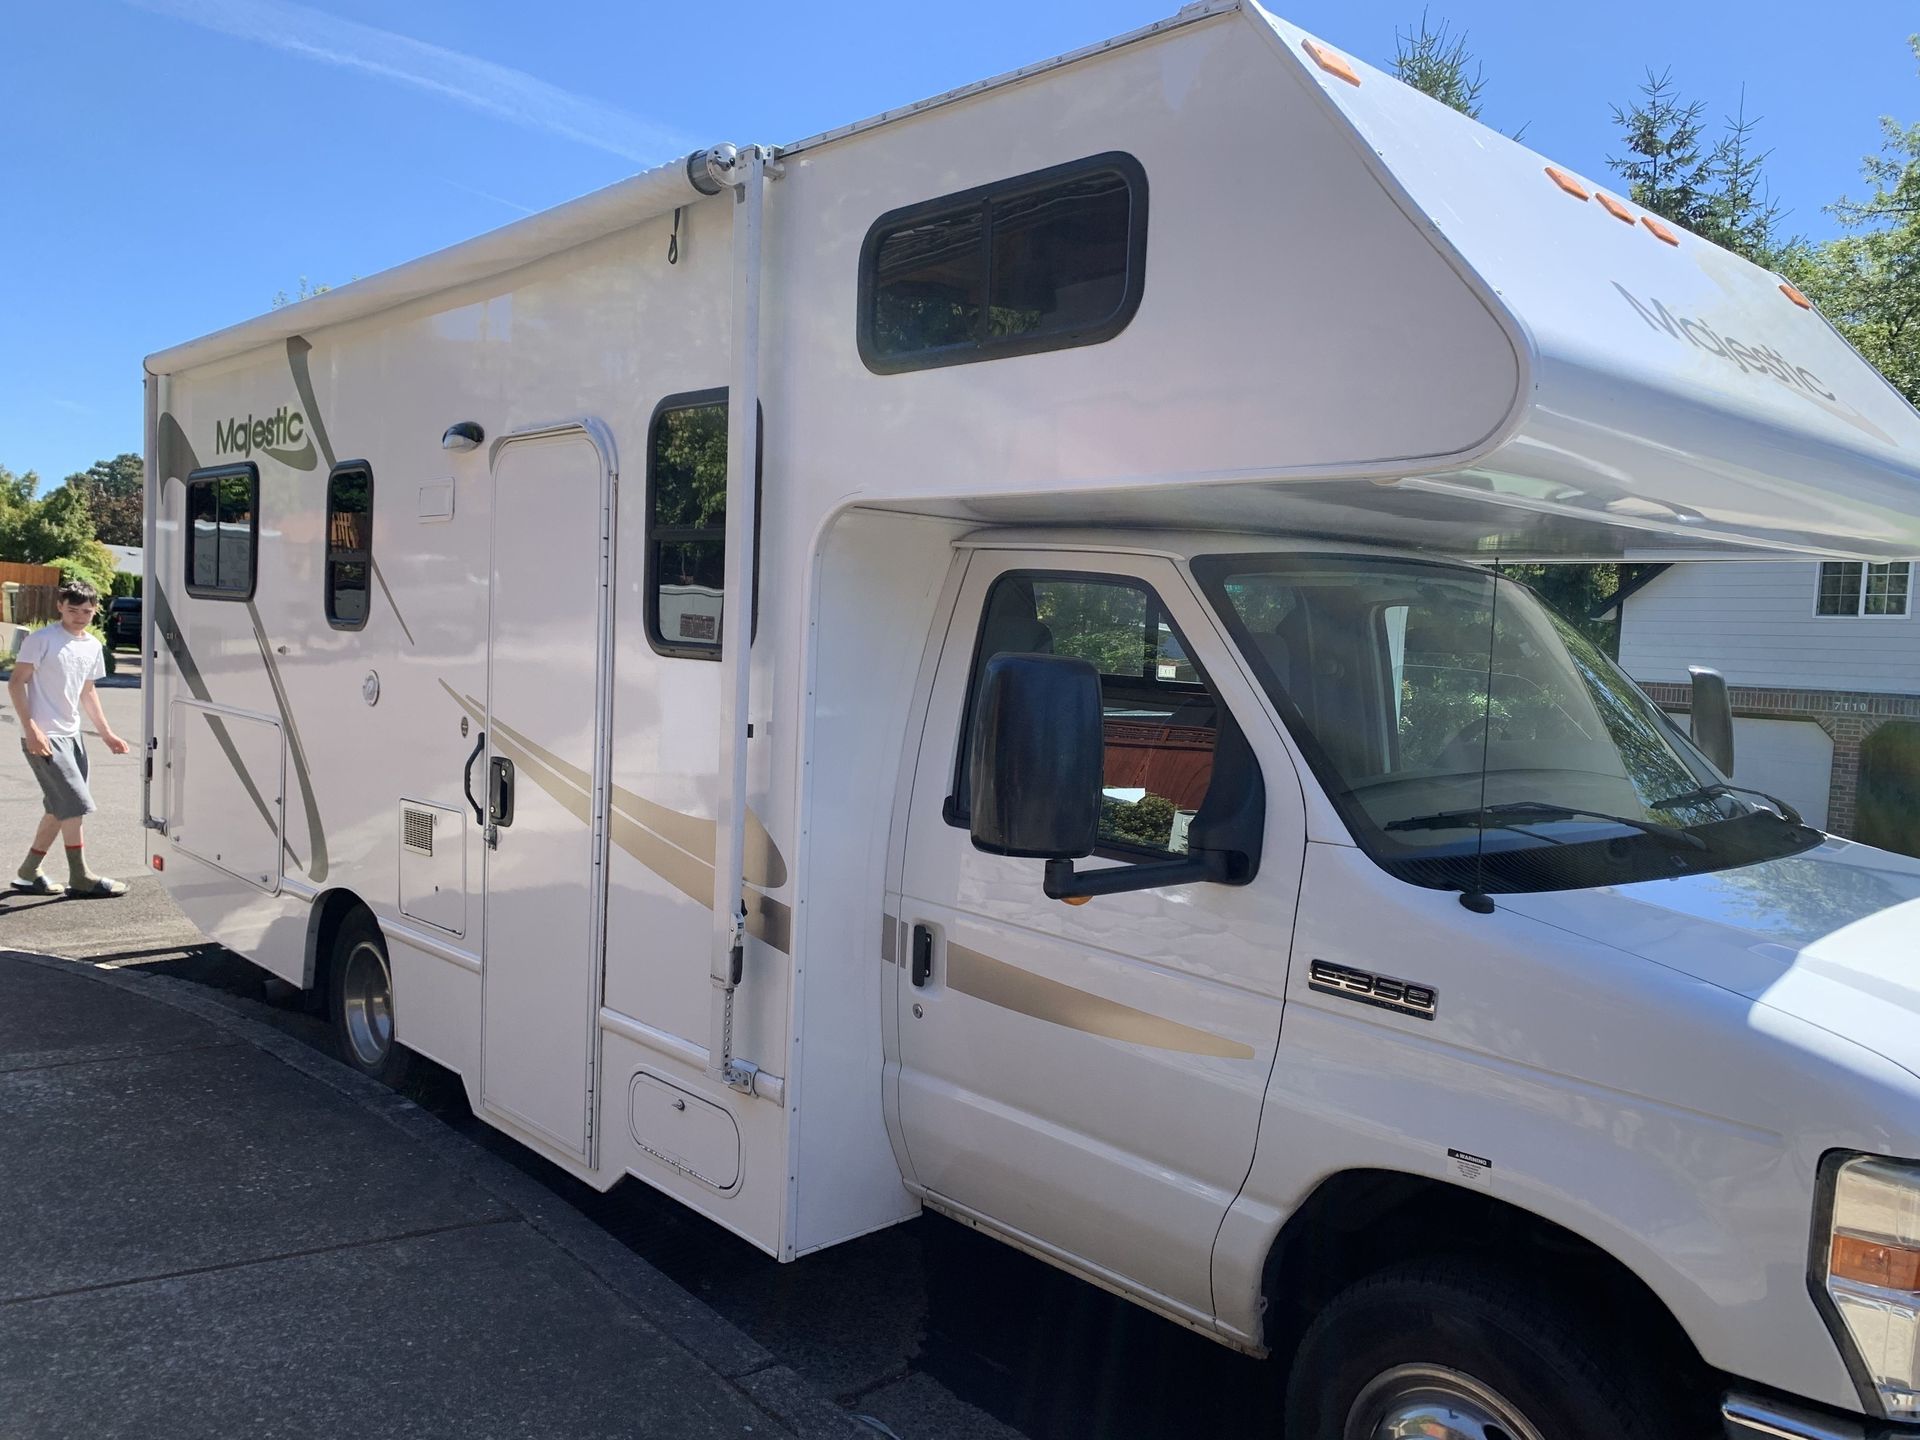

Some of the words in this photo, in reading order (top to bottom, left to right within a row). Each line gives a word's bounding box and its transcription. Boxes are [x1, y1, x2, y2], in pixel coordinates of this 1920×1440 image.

[1610, 280, 1837, 401] Majestic
[216, 406, 304, 459] Majestic
[1833, 701, 1867, 712] 7110
[1460, 1152, 1487, 1166] WARNING
